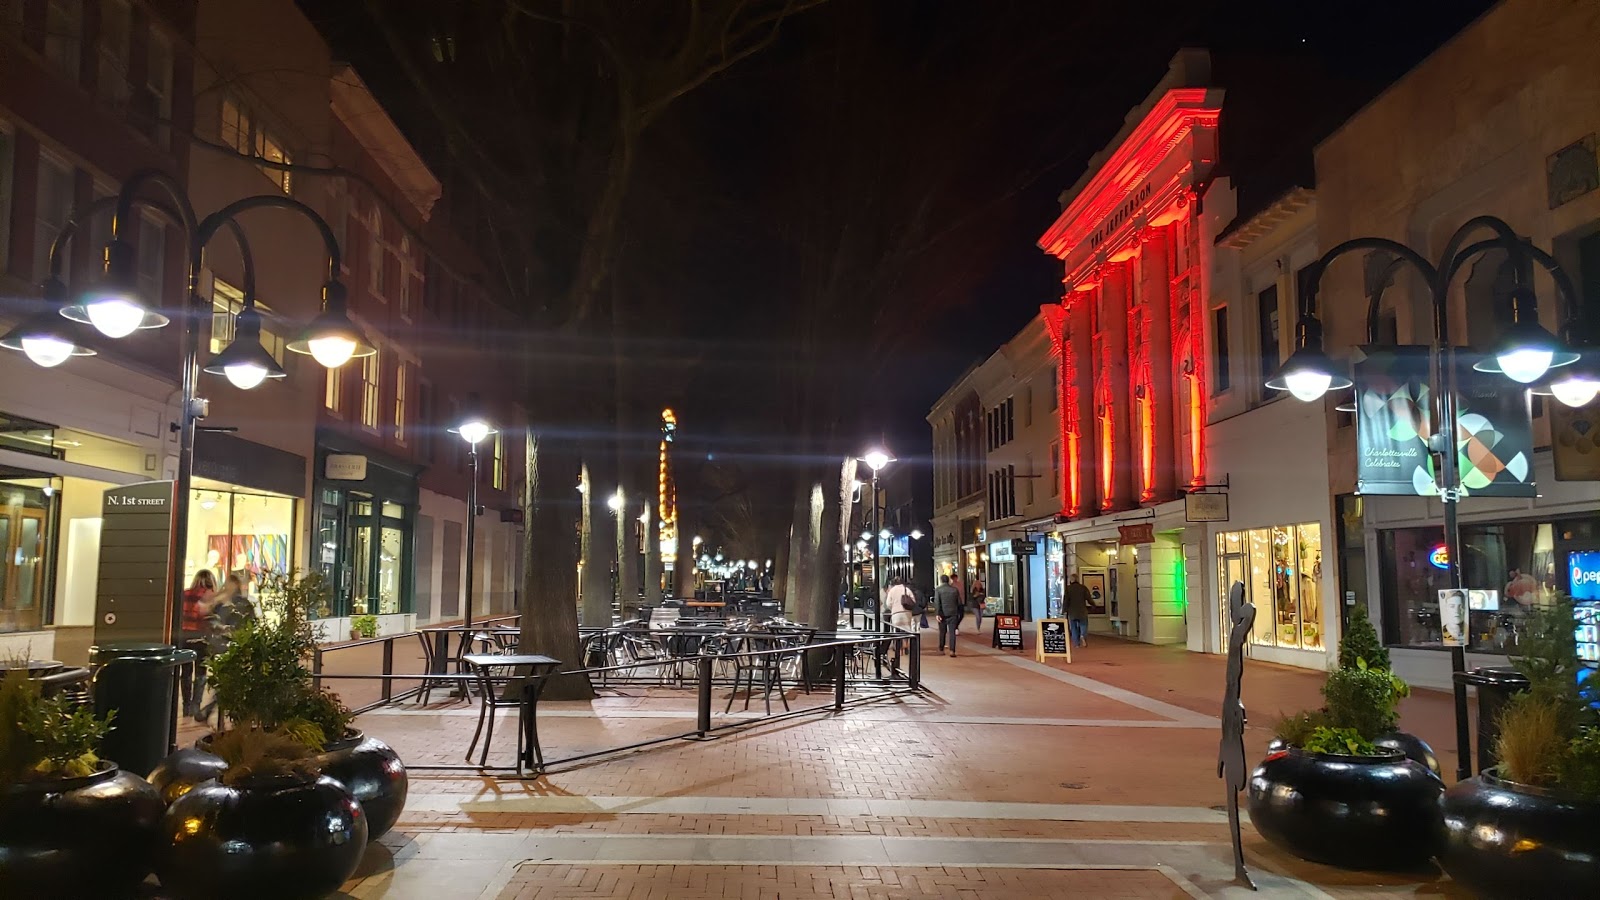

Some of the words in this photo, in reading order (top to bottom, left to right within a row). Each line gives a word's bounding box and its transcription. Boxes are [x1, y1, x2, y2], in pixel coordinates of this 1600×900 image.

[1090, 229, 1103, 249] THE
[1105, 182, 1151, 236] JEFFERSON
[1364, 446, 1418, 458] Charlottesville
[1364, 457, 1401, 468] Celebrates
[107, 495, 119, 506] N.
[121, 495, 137, 506] 1st
[137, 498, 165, 506] STREET
